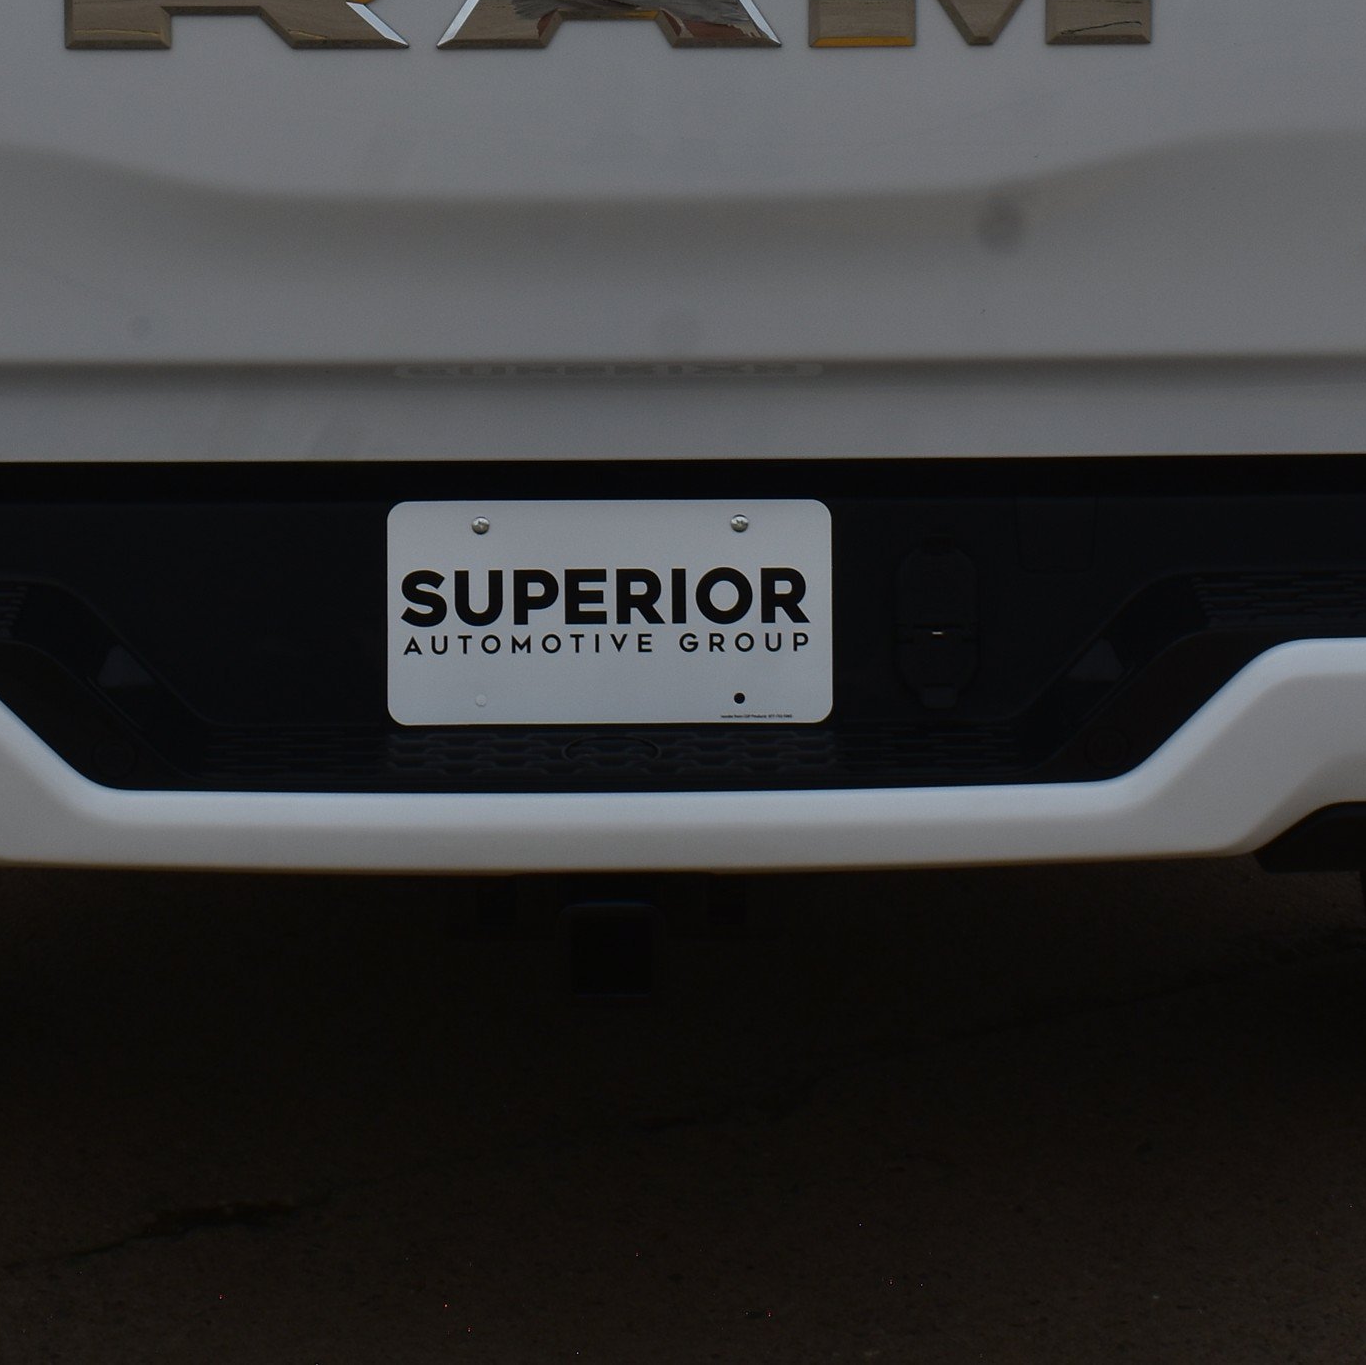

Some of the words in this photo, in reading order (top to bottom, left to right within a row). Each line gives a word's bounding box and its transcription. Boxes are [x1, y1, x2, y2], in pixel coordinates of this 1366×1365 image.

[400, 566, 811, 628] SUPERIOR
[403, 633, 653, 656] AUTOMOTIVE
[679, 631, 810, 653] GROUP
